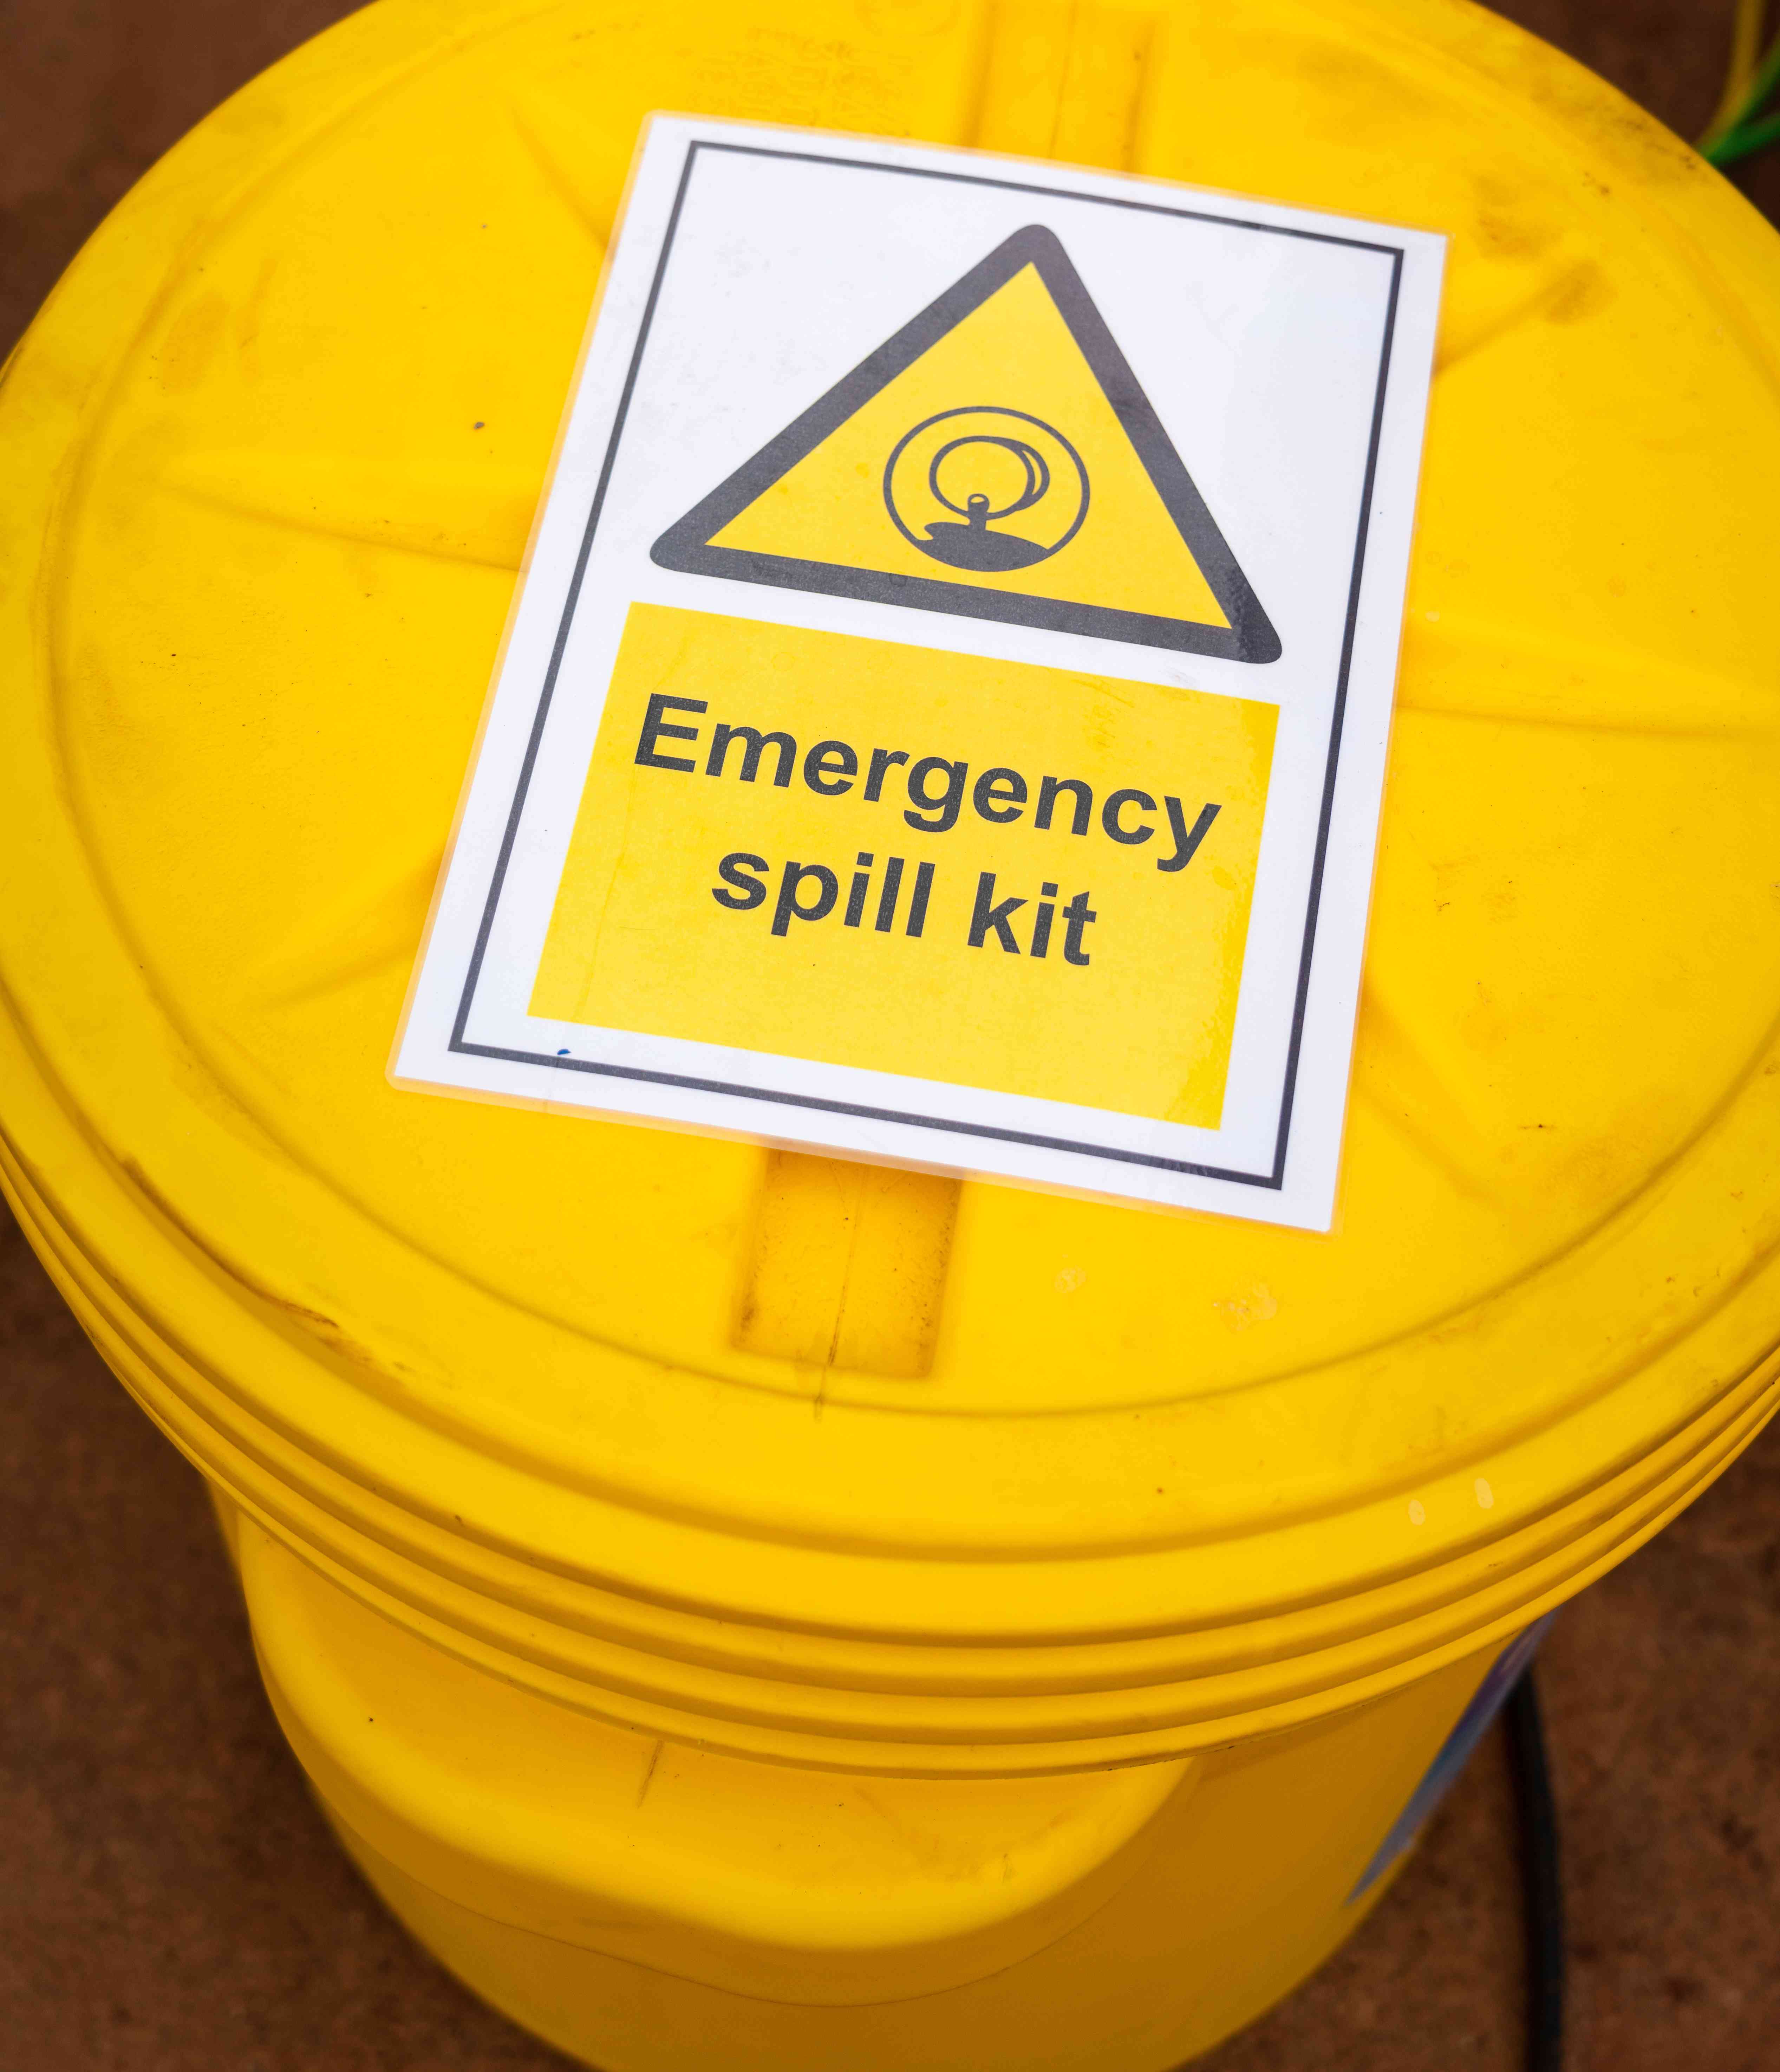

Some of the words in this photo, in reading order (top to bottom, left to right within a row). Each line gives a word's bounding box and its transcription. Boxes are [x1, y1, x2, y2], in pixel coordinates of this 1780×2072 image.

[634, 693, 1222, 872] Emergency
[712, 852, 935, 937] spill
[967, 872, 1097, 966] kit
